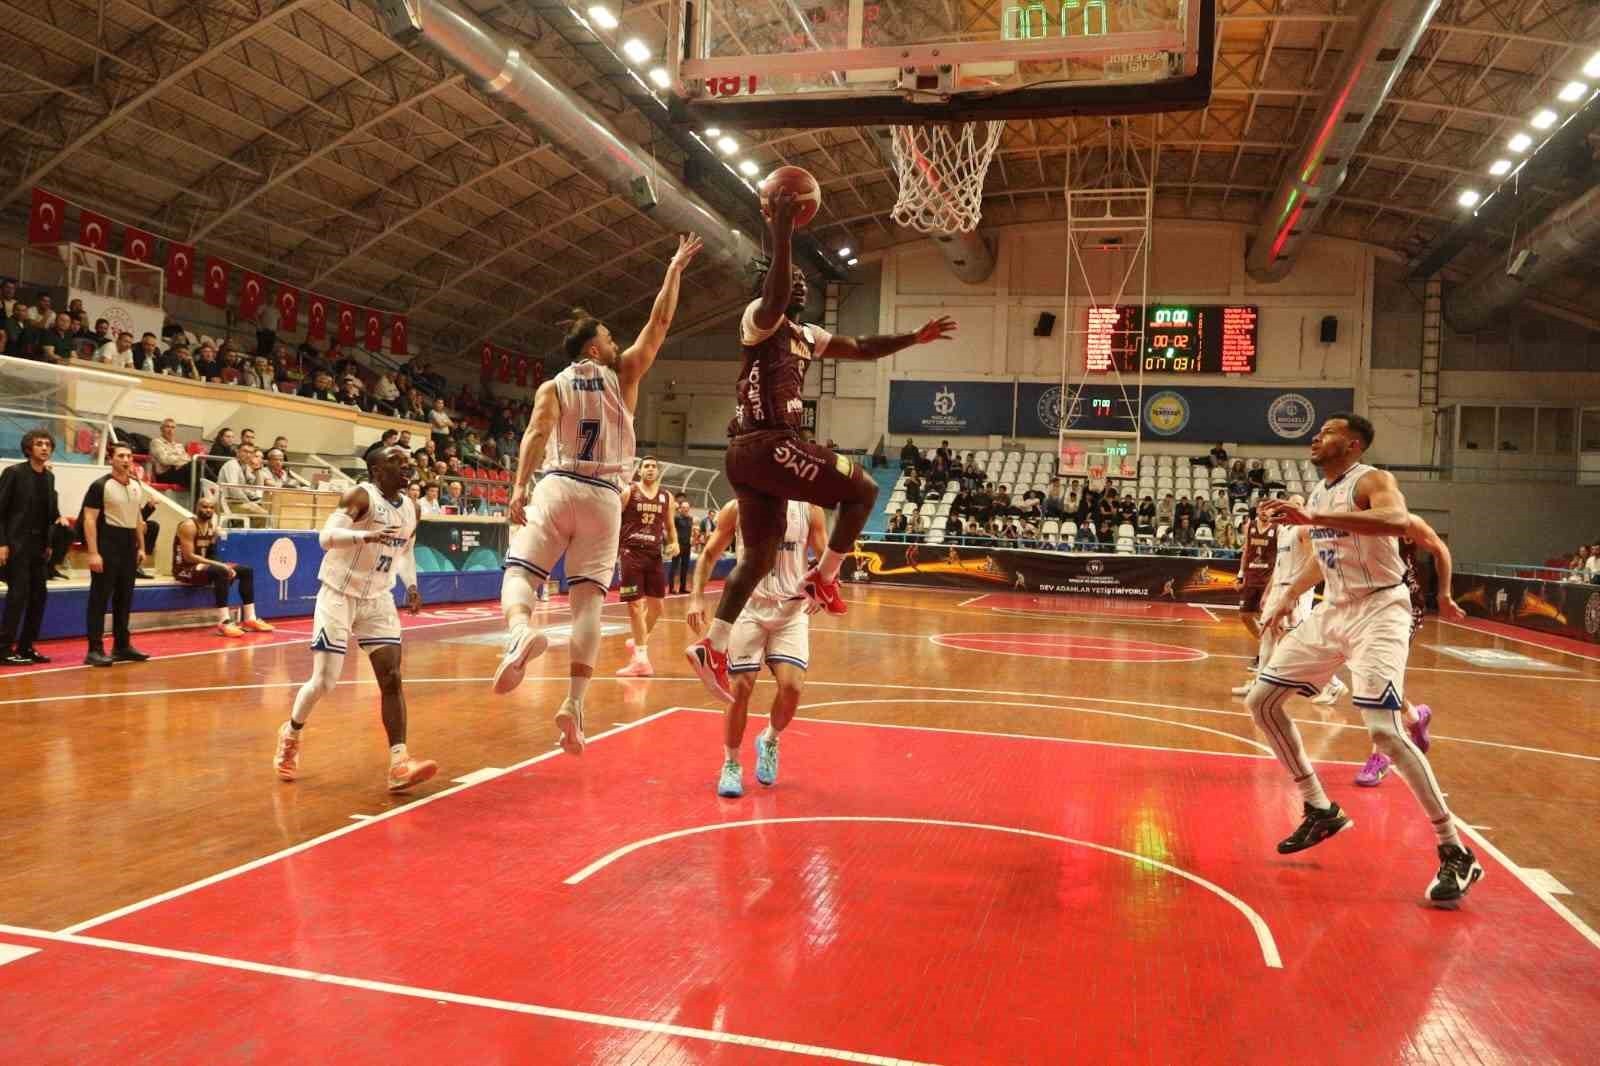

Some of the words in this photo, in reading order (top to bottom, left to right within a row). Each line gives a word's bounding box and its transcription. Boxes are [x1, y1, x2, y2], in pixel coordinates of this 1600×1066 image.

[577, 419, 600, 461] 7
[773, 447, 819, 481] UMG
[641, 512, 655, 525] 32
[1039, 584, 1055, 592] DEV
